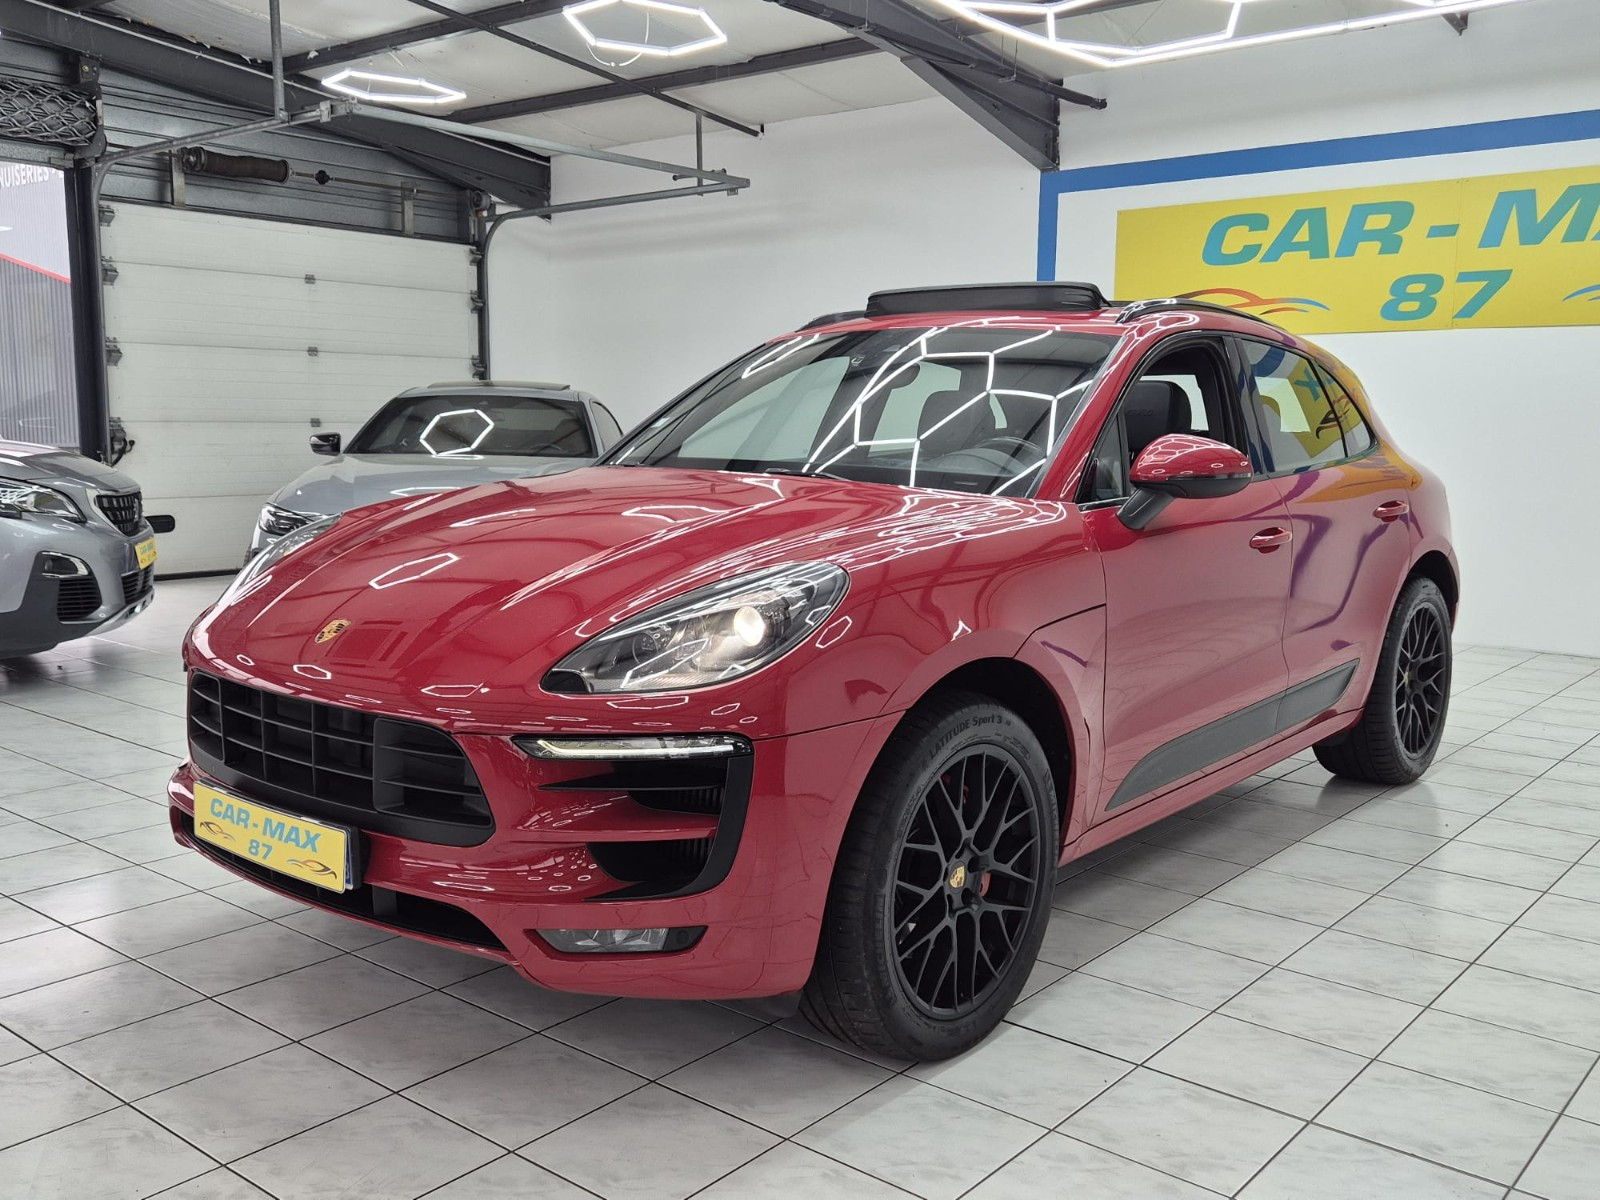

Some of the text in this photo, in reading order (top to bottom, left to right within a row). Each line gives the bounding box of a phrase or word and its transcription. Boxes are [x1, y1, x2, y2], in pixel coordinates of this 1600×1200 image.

[1380, 269, 1513, 321] 87
[928, 713, 1003, 759] LATITUDE Sport 3
[247, 839, 273, 860] 87
